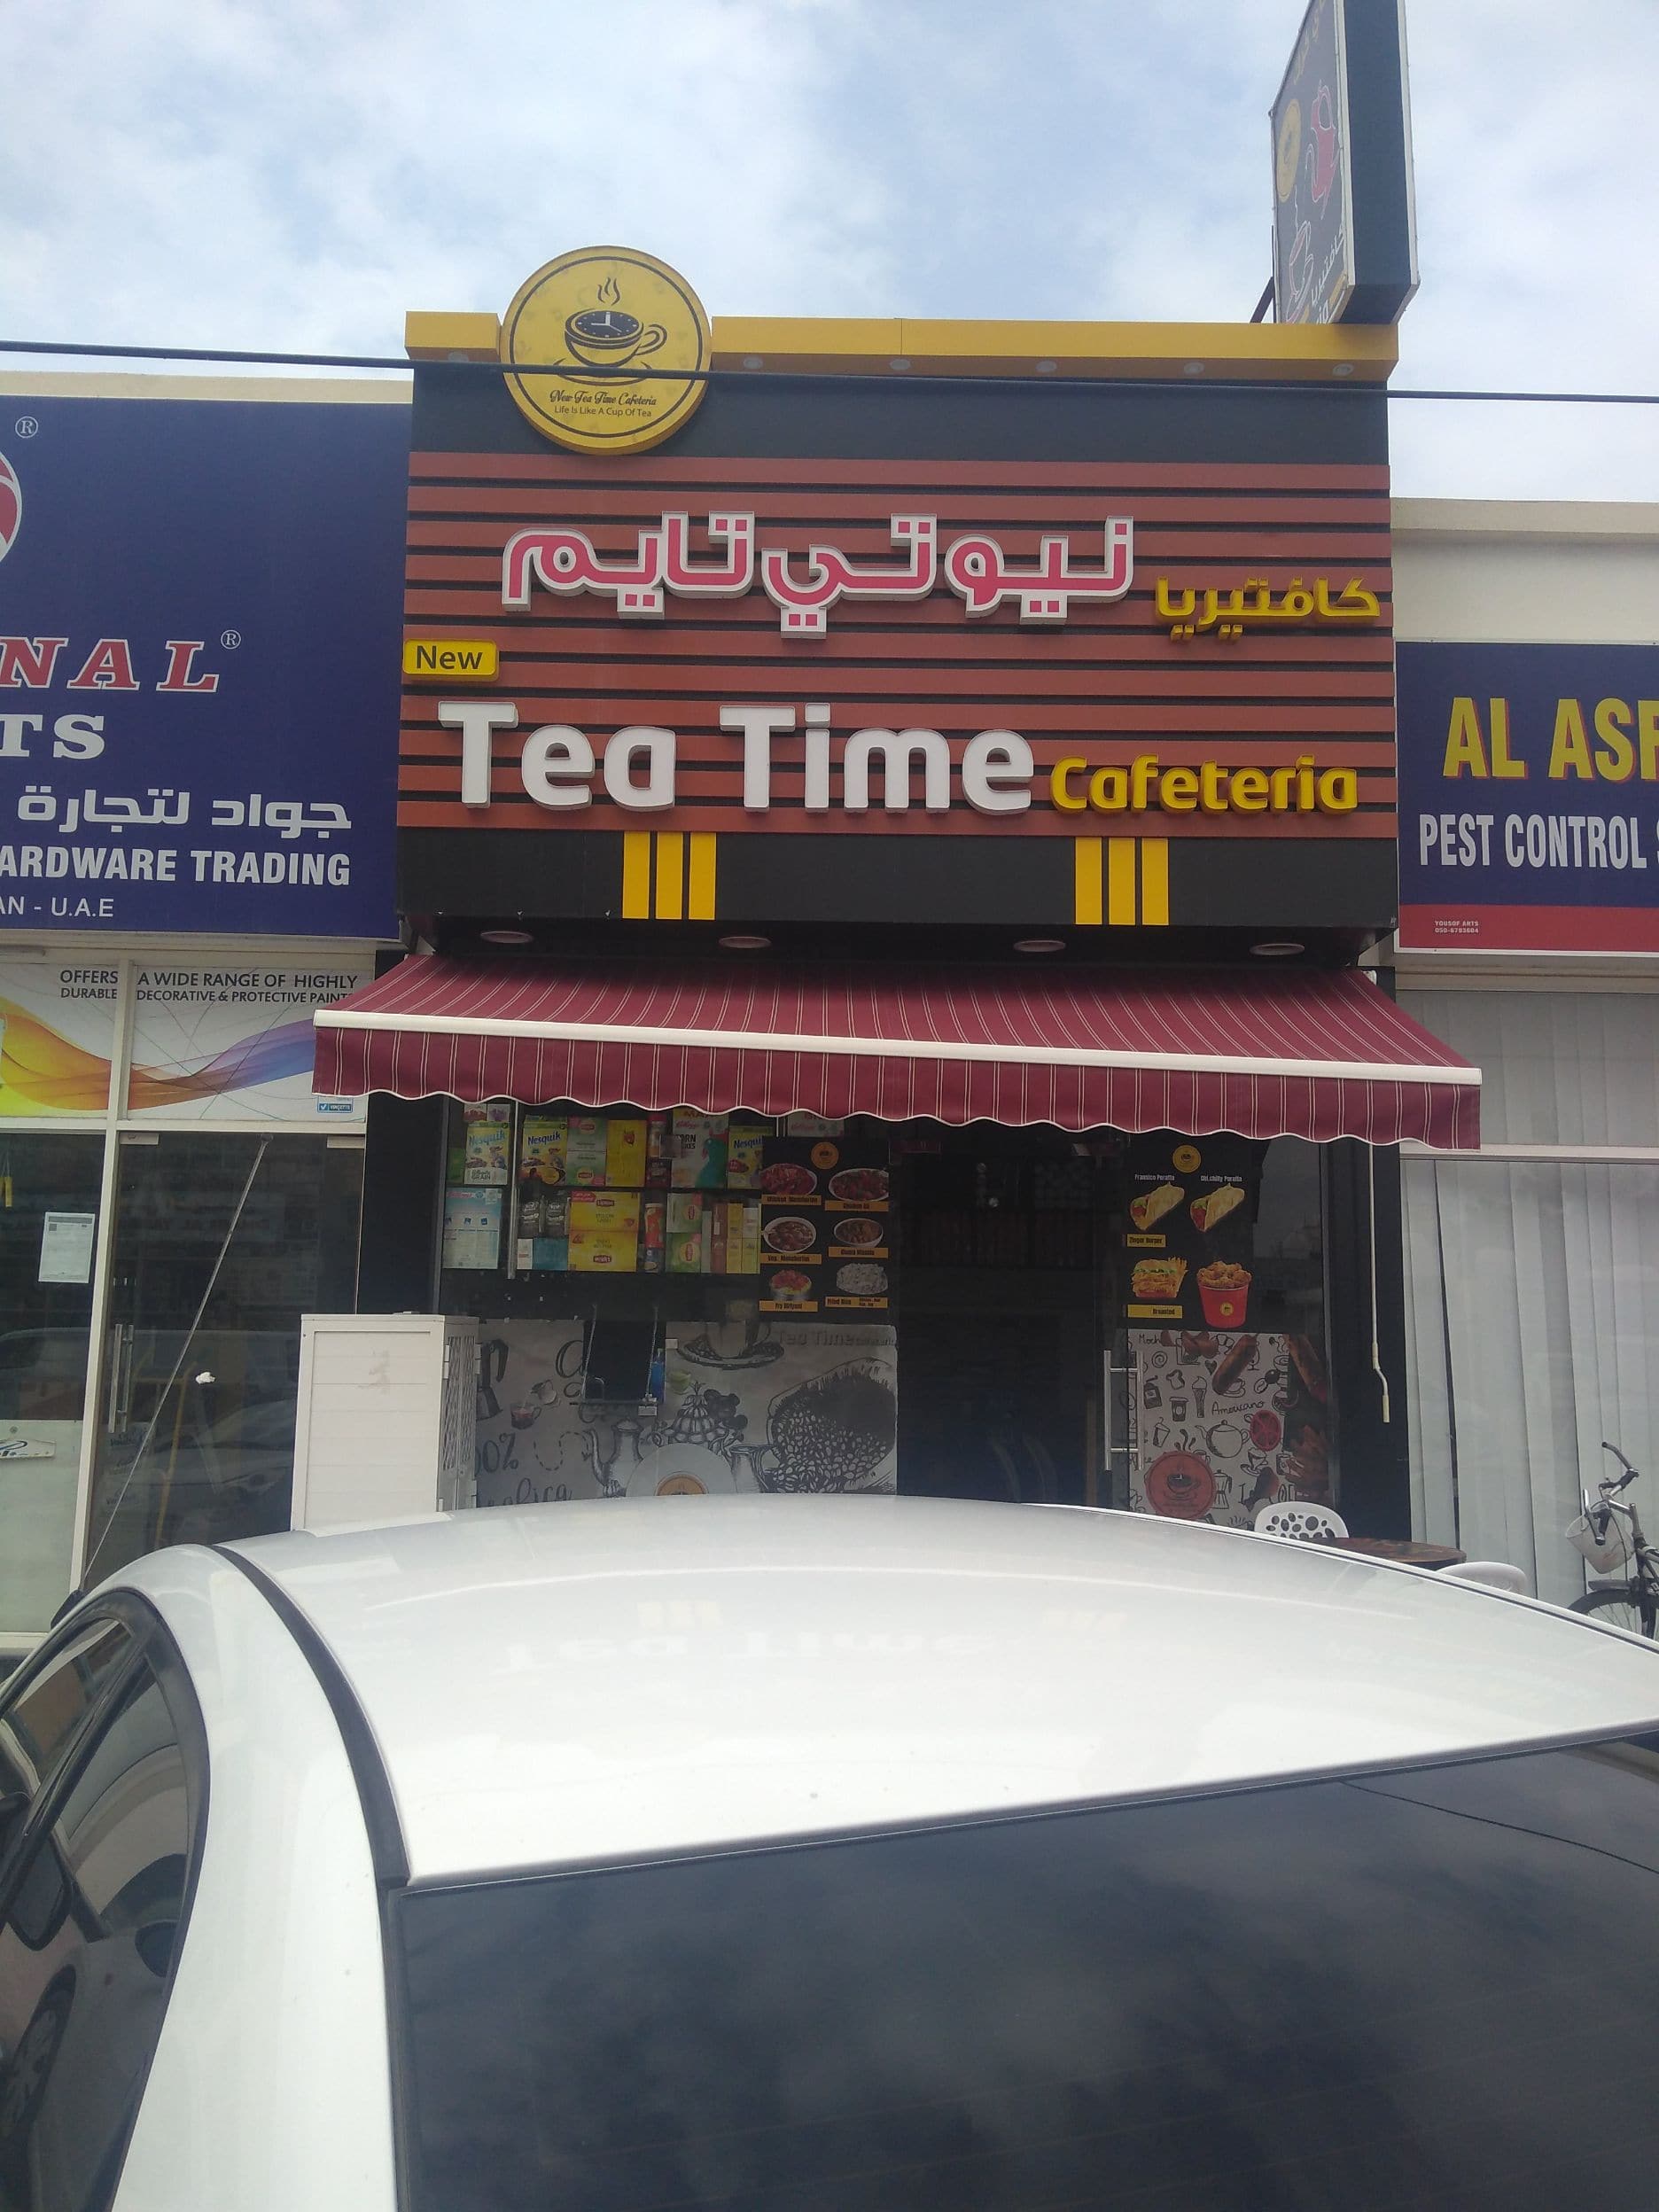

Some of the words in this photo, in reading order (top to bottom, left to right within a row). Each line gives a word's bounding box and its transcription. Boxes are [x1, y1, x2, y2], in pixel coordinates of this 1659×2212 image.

[574, 391, 592, 403] Tea
[594, 392, 617, 404] Time
[618, 393, 658, 406] Cafeteria
[606, 408, 624, 417] Cup
[637, 409, 652, 417] Tea
[1156, 576, 1381, 643] كافتيريا
[416, 644, 483, 671] New
[0, 713, 105, 760] TS
[1442, 697, 1528, 780] AL
[438, 700, 677, 812] Tea
[719, 702, 1034, 815] Time
[1050, 753, 1359, 816] Cafeteria
[17, 785, 190, 833] لتجارة
[211, 792, 352, 839] جواد
[1419, 813, 1494, 867] PEST
[1505, 814, 1647, 870] CONTROL
[190, 849, 351, 886] TRADING
[51, 897, 114, 918] U.A.E
[60, 970, 119, 984] OFFERS
[137, 972, 150, 985] A
[153, 971, 199, 986] WIDE
[203, 973, 260, 987] RANGE
[264, 974, 286, 987] OF
[294, 975, 358, 989] HIGHLY
[60, 987, 118, 1000] DURABLE
[136, 990, 215, 1001] DECORATIVE
[218, 992, 228, 1001] &
[231, 991, 307, 1003] PROTECTIVE
[526, 1131, 562, 1146] Nesquik
[1211, 1399, 1266, 1416] Americano
